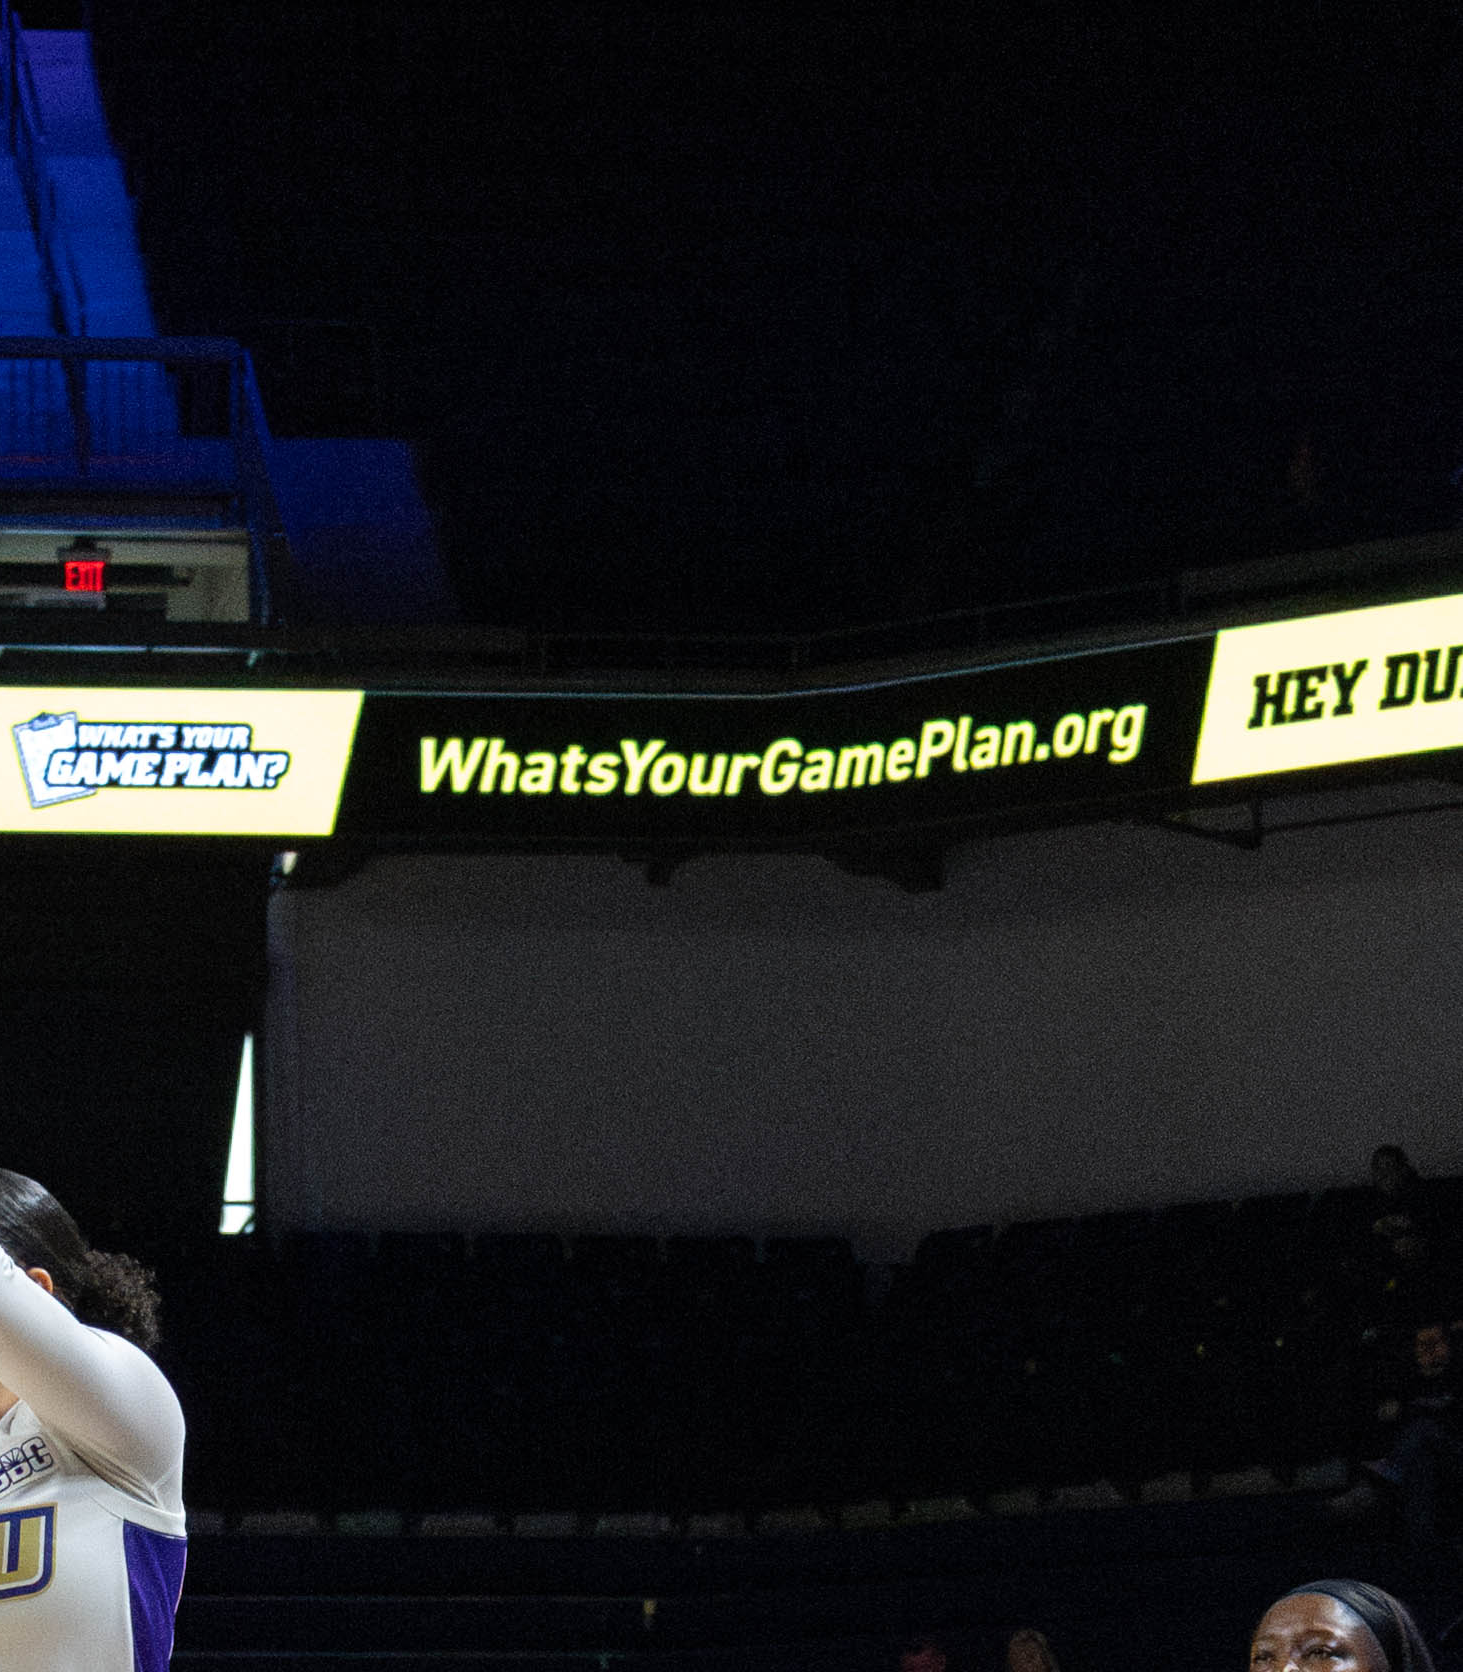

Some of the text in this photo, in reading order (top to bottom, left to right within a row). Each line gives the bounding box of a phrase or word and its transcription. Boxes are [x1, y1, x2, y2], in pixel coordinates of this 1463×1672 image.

[64, 561, 105, 592] EXIT
[1249, 660, 1368, 730] HEY
[77, 724, 251, 752] WHAT'S YOUR
[417, 702, 1146, 797] WhatsYourGamePlan.org
[46, 752, 290, 788] GAME PLAN?
